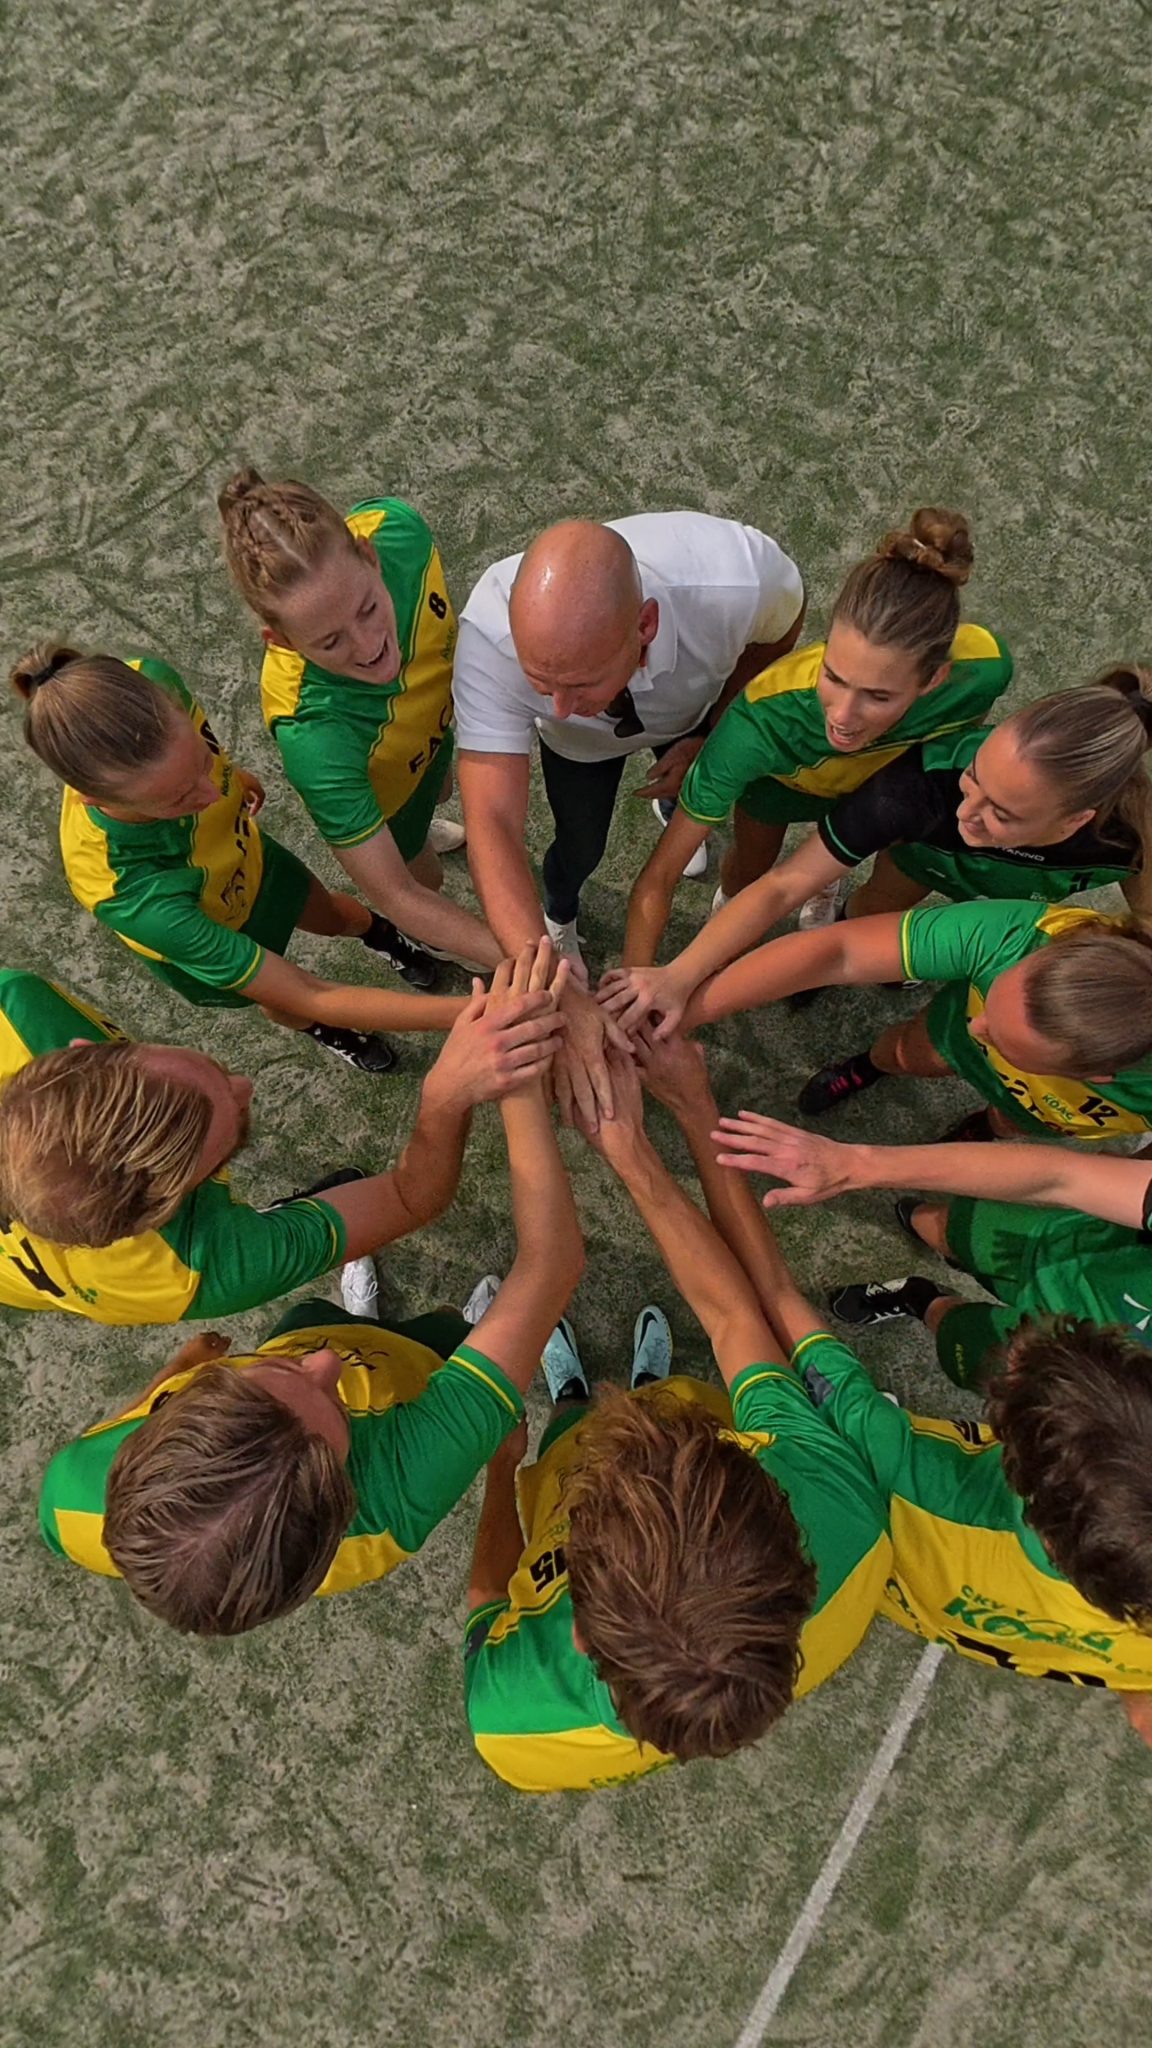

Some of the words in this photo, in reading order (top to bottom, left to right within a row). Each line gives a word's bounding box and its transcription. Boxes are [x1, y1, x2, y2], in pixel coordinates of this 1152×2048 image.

[429, 592, 447, 620] 8
[1079, 1095, 1119, 1127] 12
[529, 1548, 568, 1593] 15
